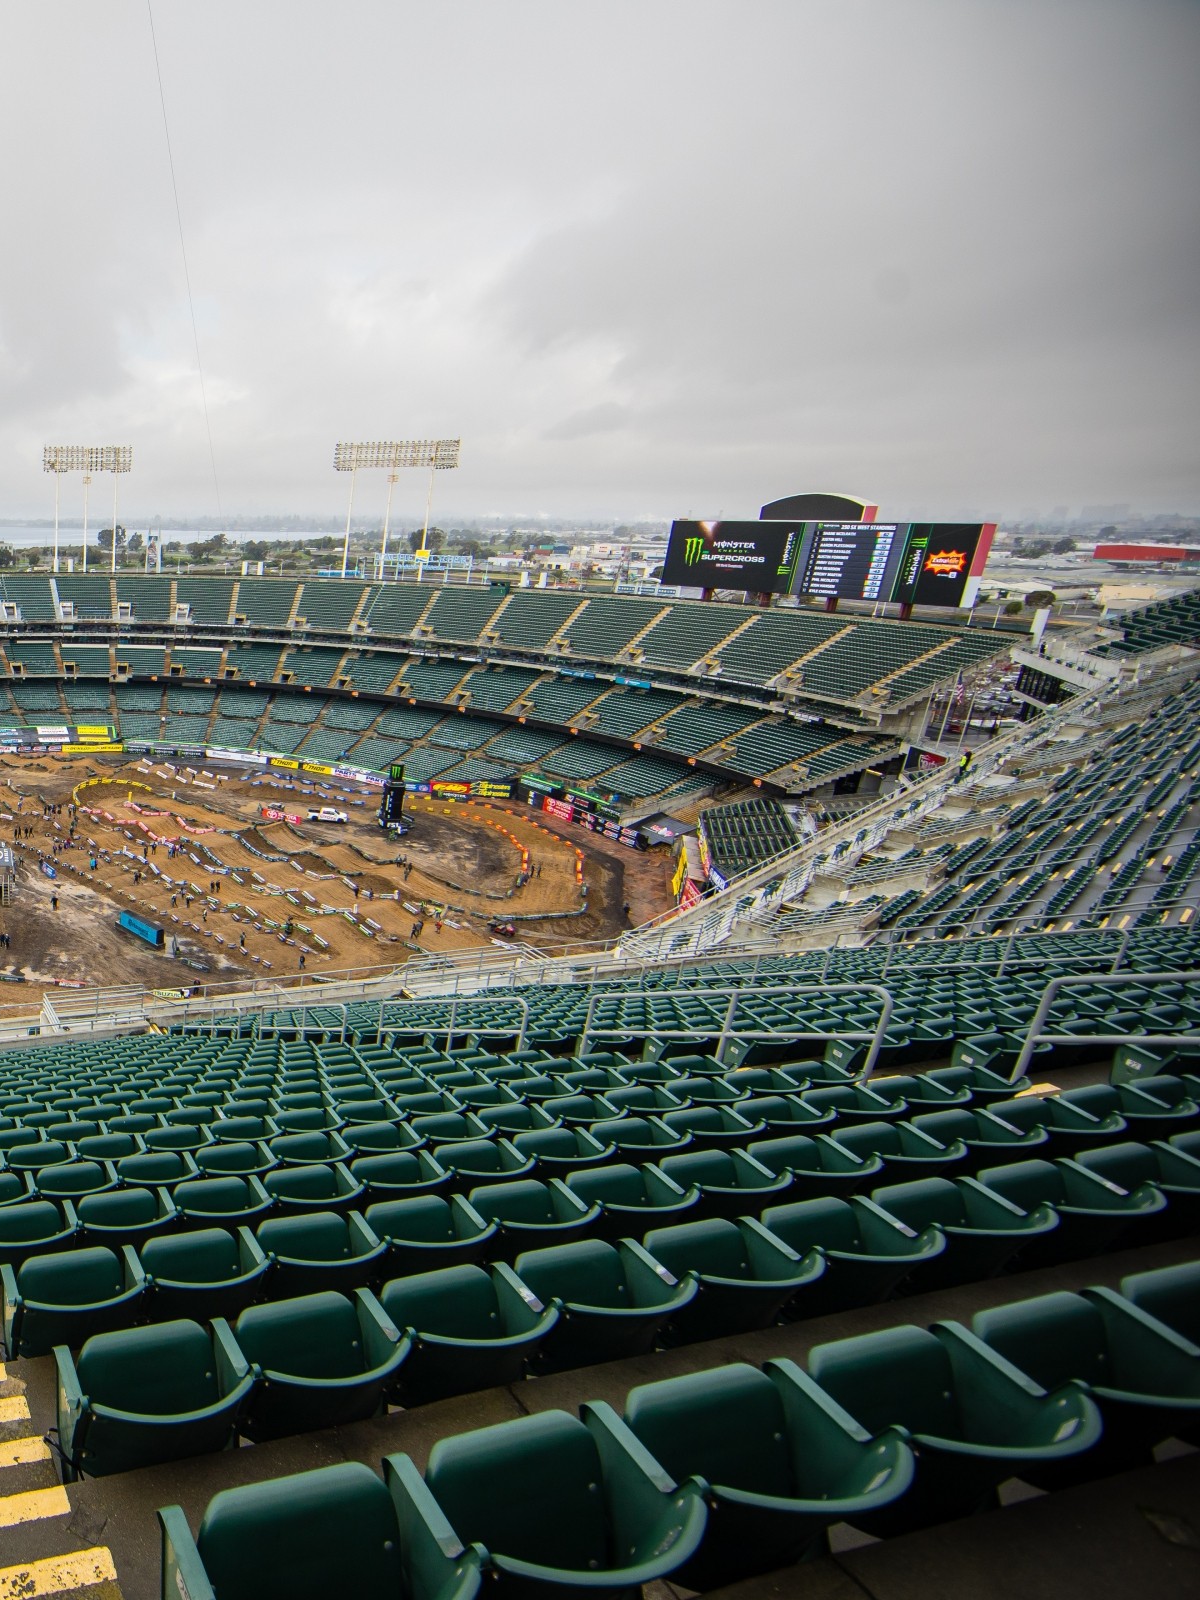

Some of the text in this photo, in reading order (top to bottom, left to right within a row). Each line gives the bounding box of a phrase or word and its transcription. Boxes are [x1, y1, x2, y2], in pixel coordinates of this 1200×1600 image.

[713, 540, 756, 549] MONSTER
[782, 532, 795, 565] MONSTER
[701, 554, 765, 563] SUPERCROSS
[905, 549, 922, 585] MONSTER
[276, 759, 293, 767] THOR
[308, 764, 326, 773] THOR
